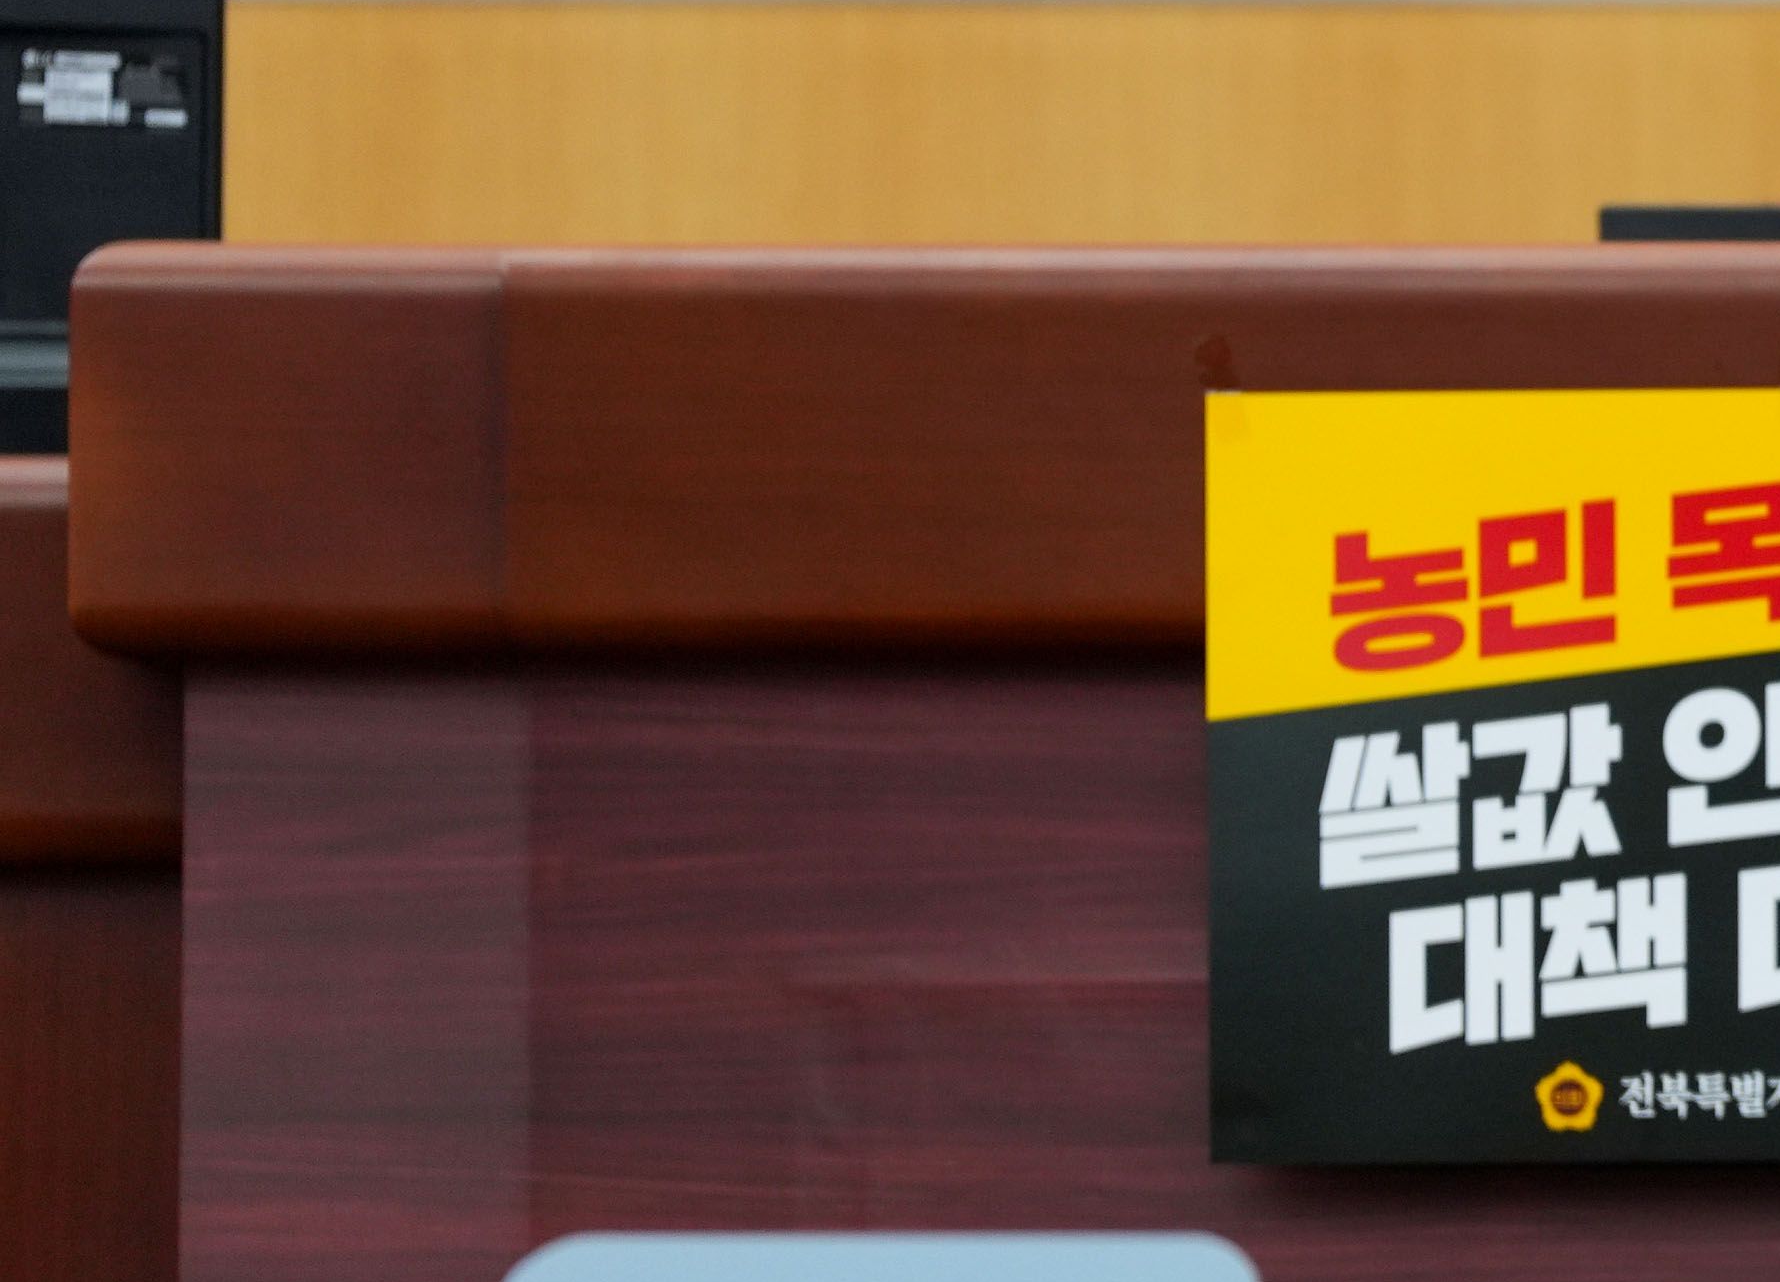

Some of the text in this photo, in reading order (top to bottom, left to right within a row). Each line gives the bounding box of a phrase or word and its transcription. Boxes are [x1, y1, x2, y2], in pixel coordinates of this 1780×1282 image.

[1330, 498, 1617, 672] 농민
[1318, 703, 1623, 889] 쌀값
[1389, 873, 1688, 1055] 대책
